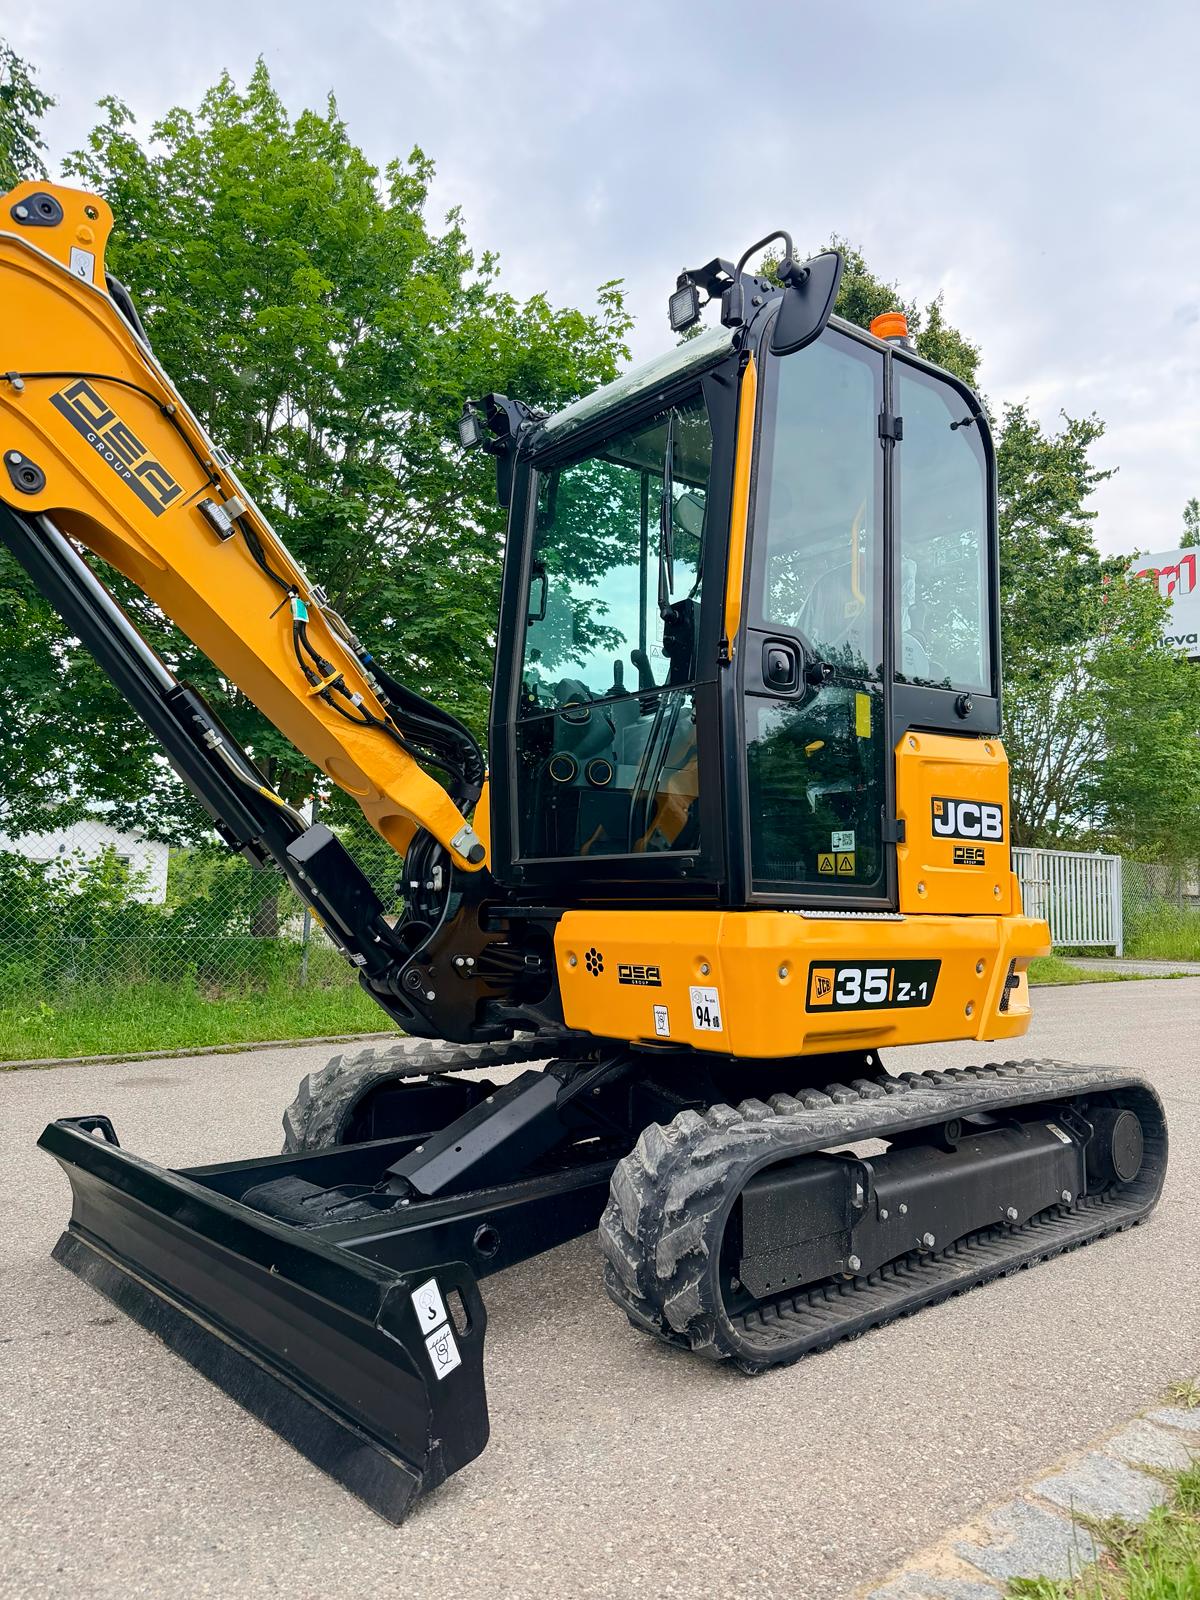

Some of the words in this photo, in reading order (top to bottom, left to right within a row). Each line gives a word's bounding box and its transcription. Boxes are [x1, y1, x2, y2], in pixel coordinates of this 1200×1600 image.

[87, 432, 131, 478] GROUP
[934, 802, 1002, 838] JCB
[817, 978, 831, 995] JCB
[836, 968, 888, 1004] 35
[696, 1005, 711, 1027] 94
